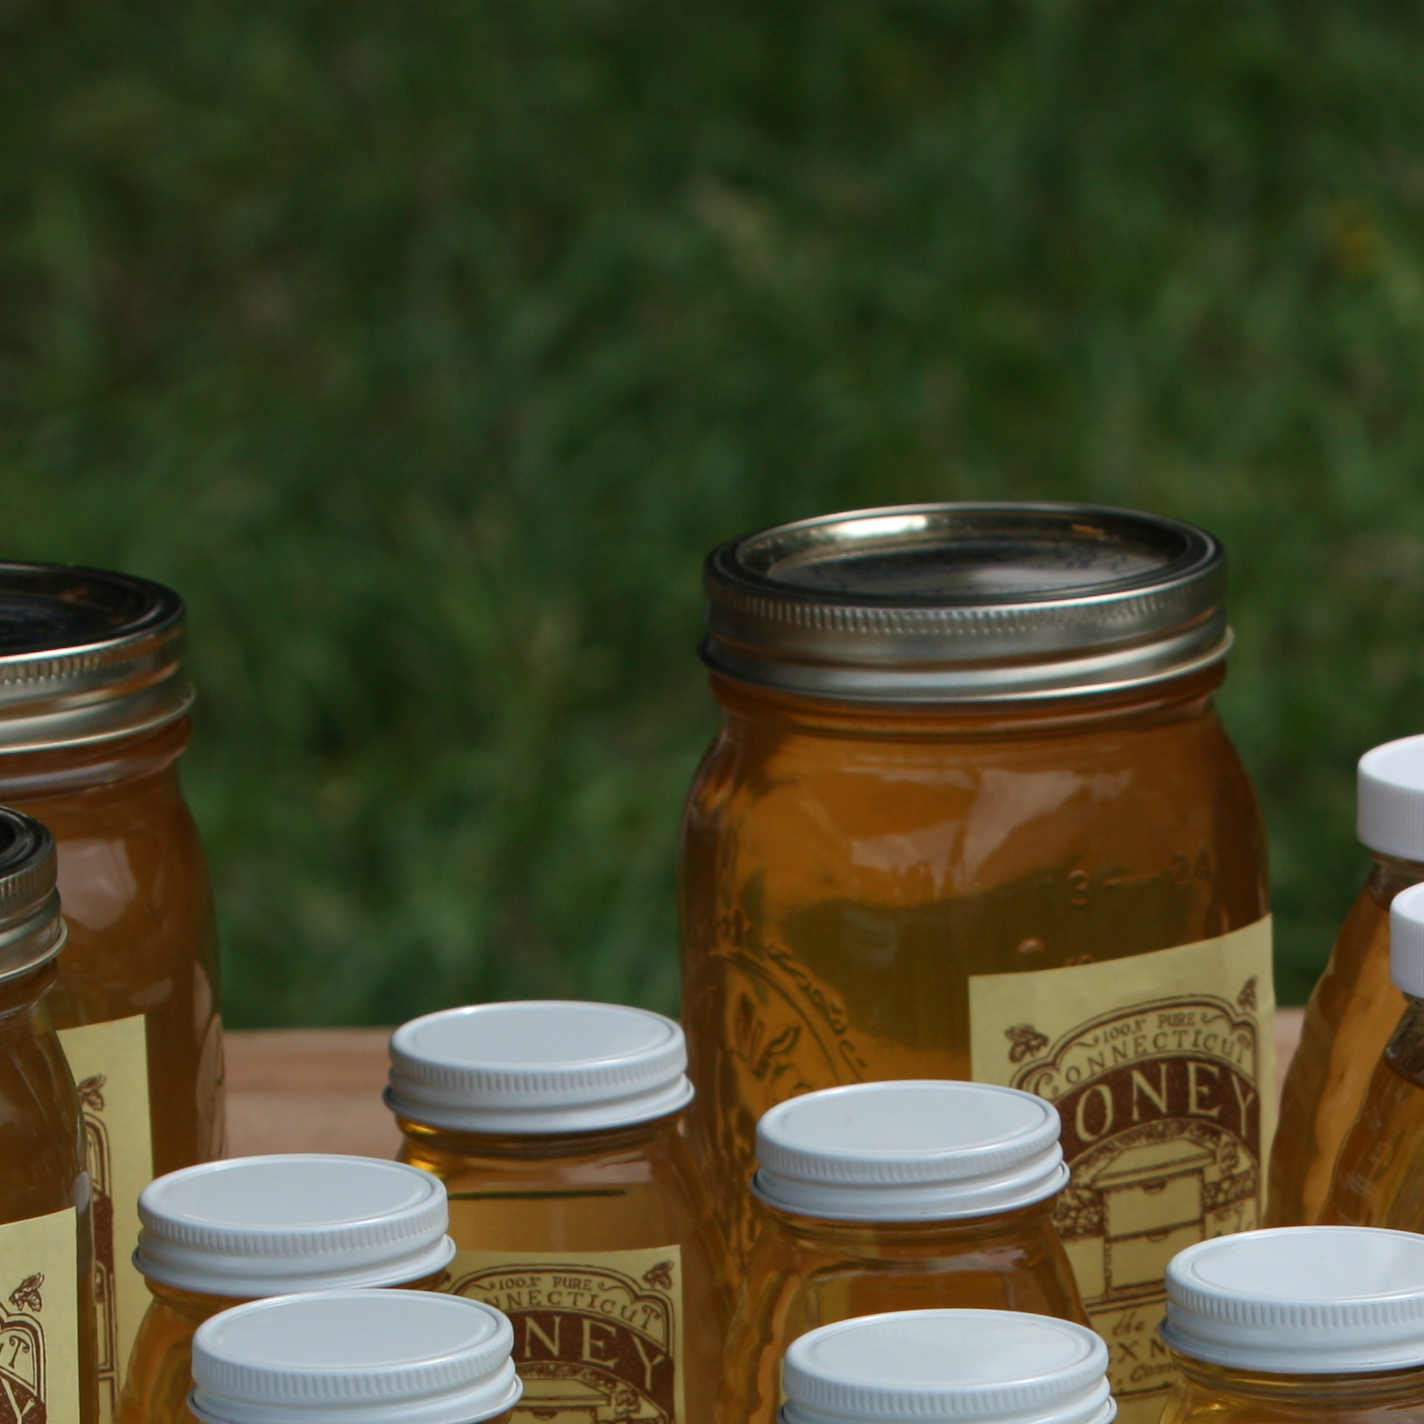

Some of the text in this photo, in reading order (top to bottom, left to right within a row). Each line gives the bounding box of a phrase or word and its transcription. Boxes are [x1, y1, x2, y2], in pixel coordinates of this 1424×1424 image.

[1158, 1012, 1195, 1027] PURE
[1037, 1030, 1251, 1099] CONNECTICUT
[1077, 1061, 1255, 1142] ONEY
[552, 1276, 592, 1290] PURE
[524, 1316, 665, 1392] NEY
